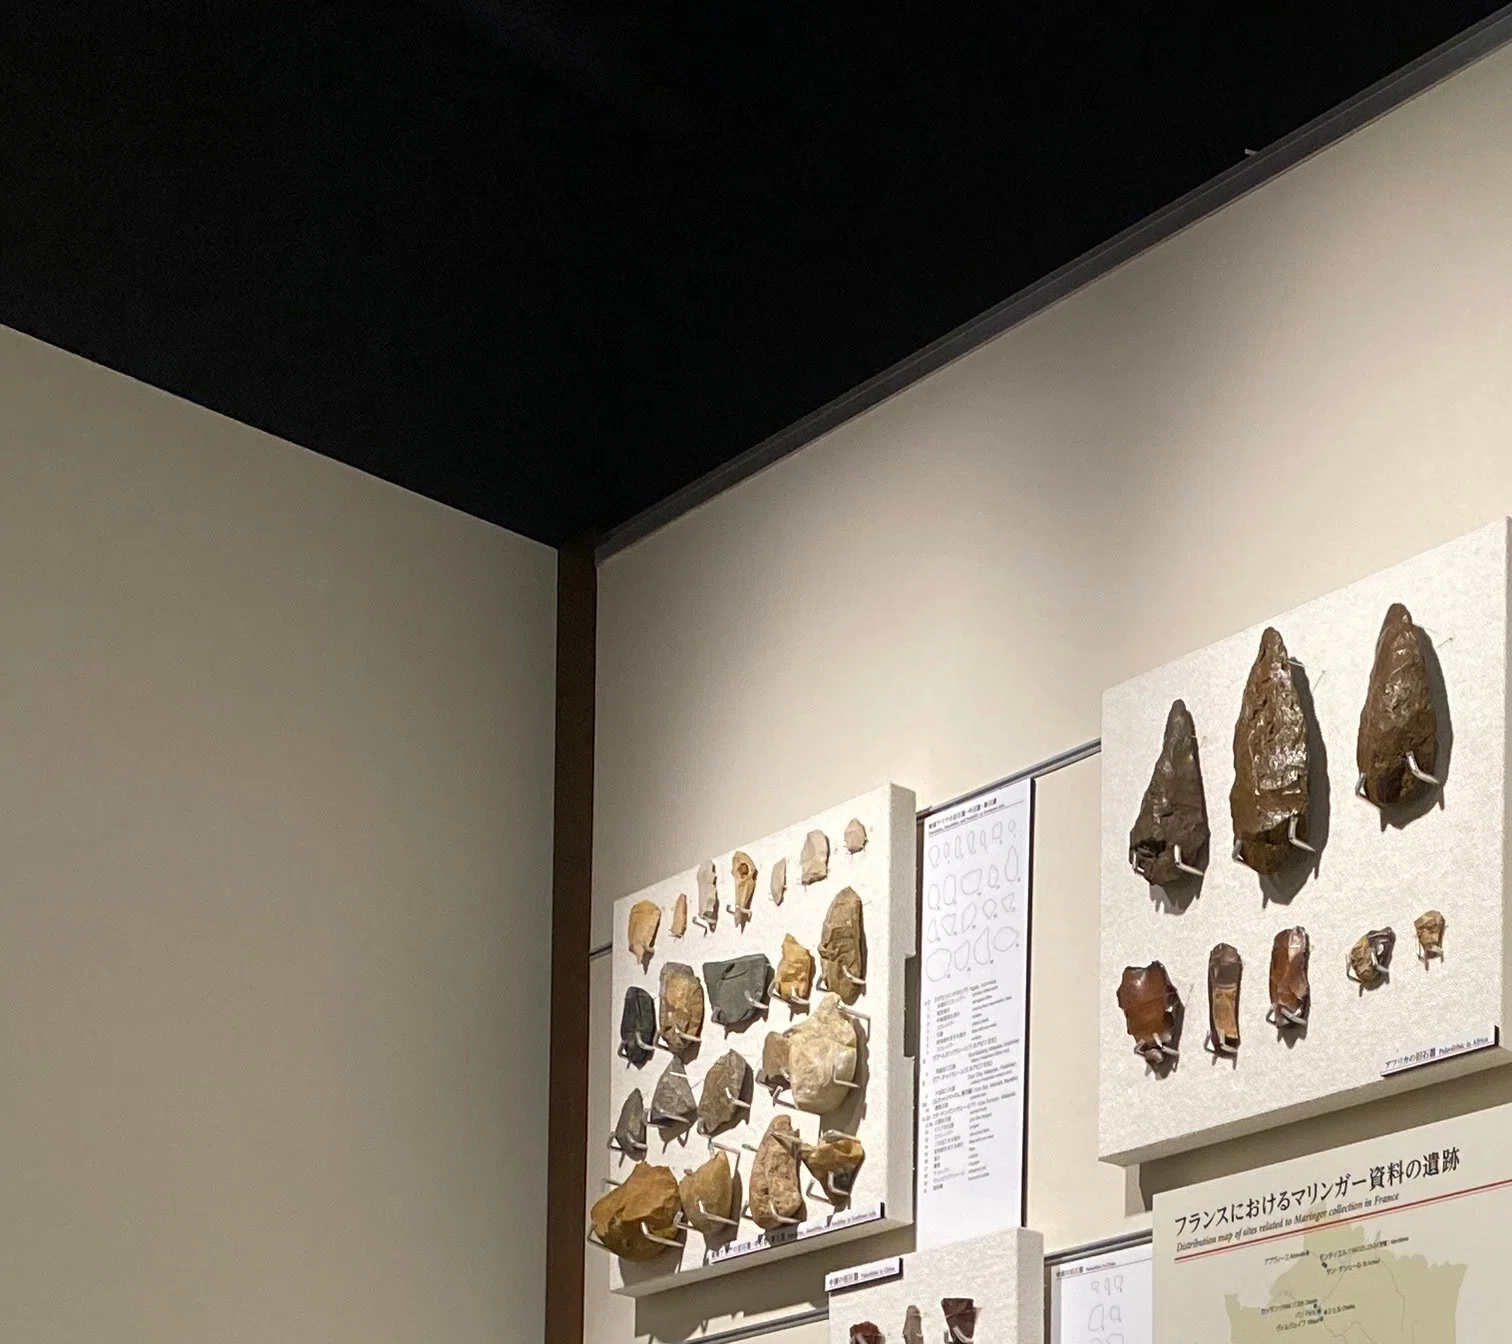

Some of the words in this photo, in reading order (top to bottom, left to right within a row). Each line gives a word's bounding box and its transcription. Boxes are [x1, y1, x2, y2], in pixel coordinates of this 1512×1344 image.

[1174, 1146, 1460, 1236] フランスにおけるマリンガー資料の遺跡
[1176, 1234, 1217, 1252] Distribution
[1218, 1232, 1233, 1243] map
[1234, 1228, 1242, 1240] of
[1243, 1226, 1258, 1236] sites
[1259, 1220, 1282, 1234] related
[1328, 1200, 1363, 1216] collection
[1364, 1198, 1372, 1206] in
[1374, 1192, 1400, 1206] France
